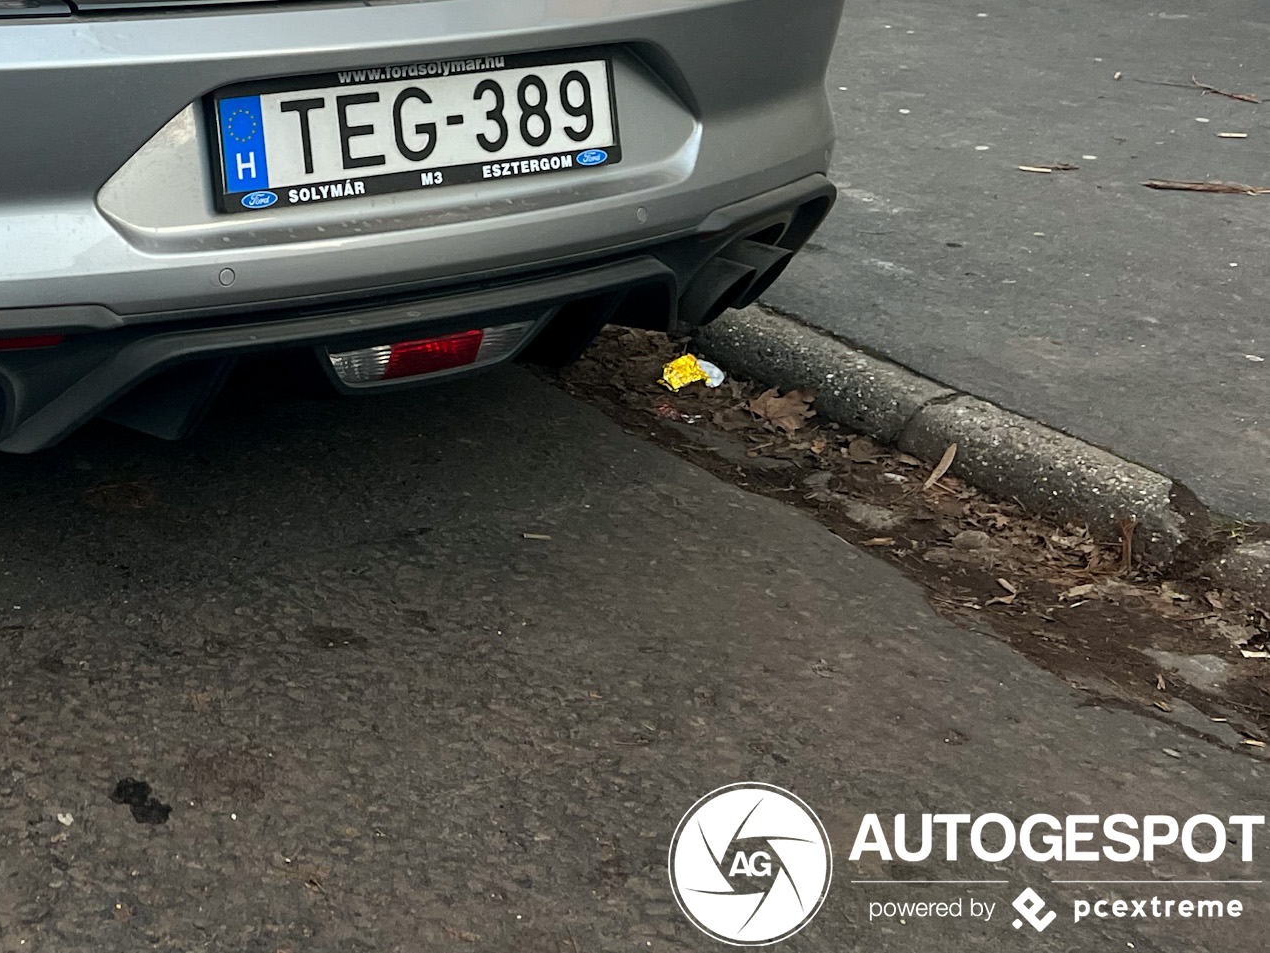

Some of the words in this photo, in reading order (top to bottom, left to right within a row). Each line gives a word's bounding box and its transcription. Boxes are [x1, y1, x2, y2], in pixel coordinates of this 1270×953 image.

[338, 56, 505, 84] www.fordsolymar.hu
[280, 69, 595, 175] TEG-389
[236, 151, 257, 180] H
[246, 192, 273, 207] Ford
[288, 179, 366, 203] SOLYMÁR
[420, 171, 443, 186] M3
[482, 154, 573, 179] ESZTERGOM
[580, 150, 603, 164] Ford
